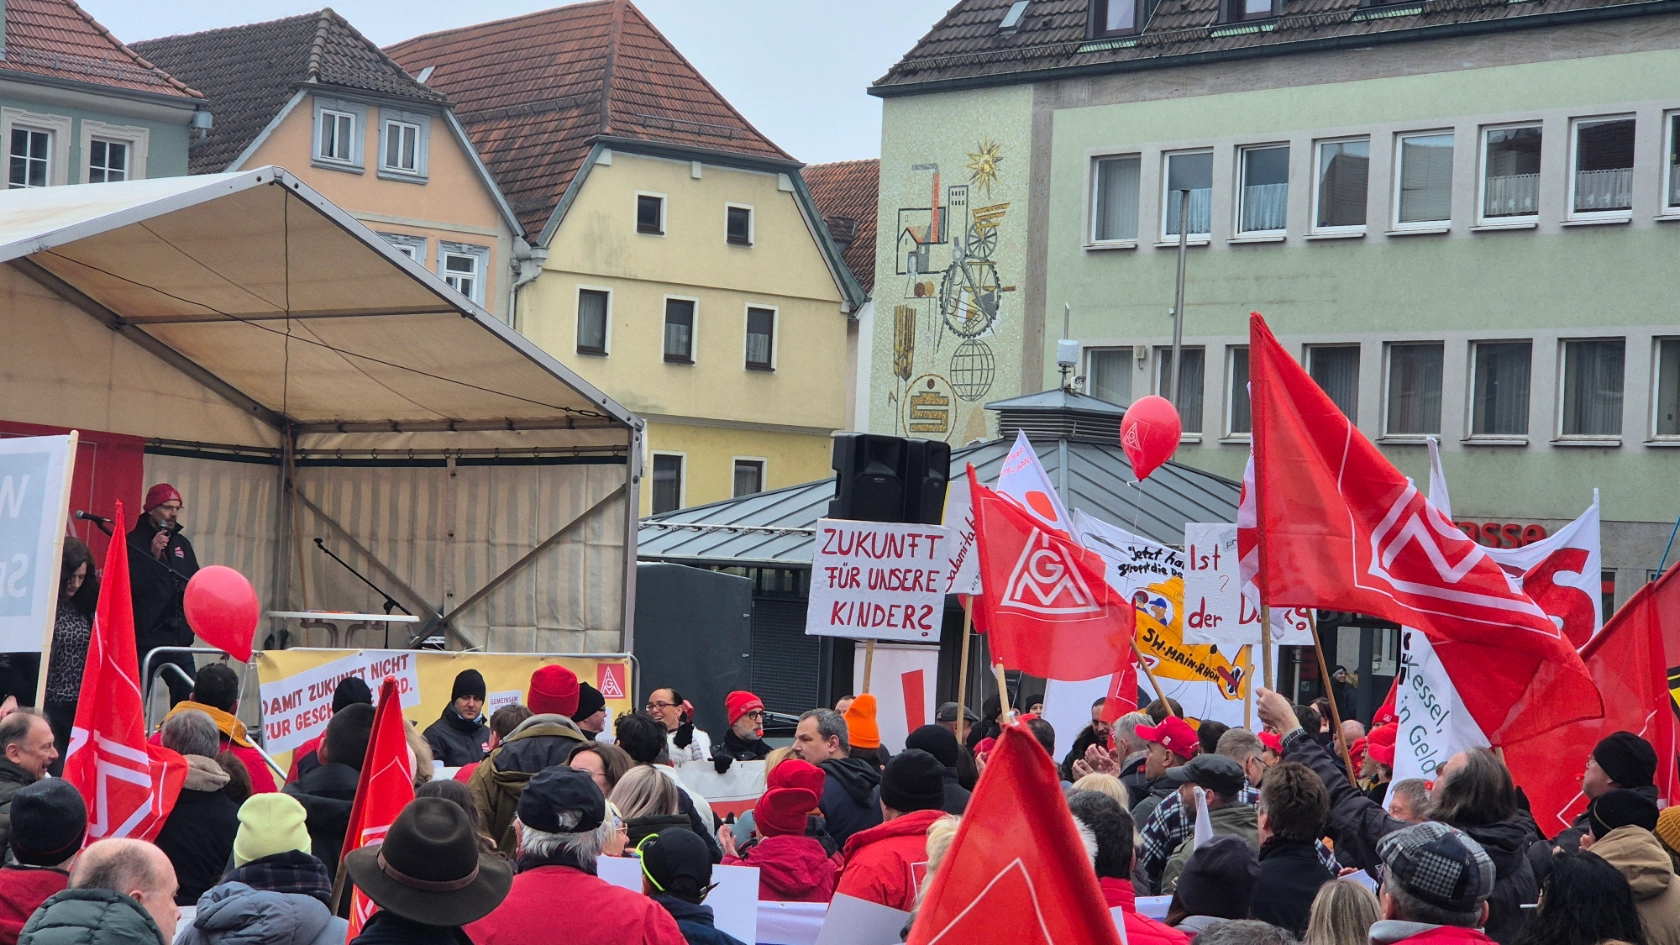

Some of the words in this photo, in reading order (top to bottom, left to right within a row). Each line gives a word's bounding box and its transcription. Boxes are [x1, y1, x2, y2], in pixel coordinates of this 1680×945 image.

[821, 528, 944, 560] ZUKUNFT
[1453, 521, 1547, 549] asse
[1190, 543, 1221, 571] Ist
[824, 562, 860, 589] FÜR
[868, 567, 940, 593] UNSERE
[831, 600, 933, 637] KINDER?
[1188, 596, 1223, 629] der
[370, 653, 409, 681] NICHT
[1406, 654, 1450, 734] Kessel,
